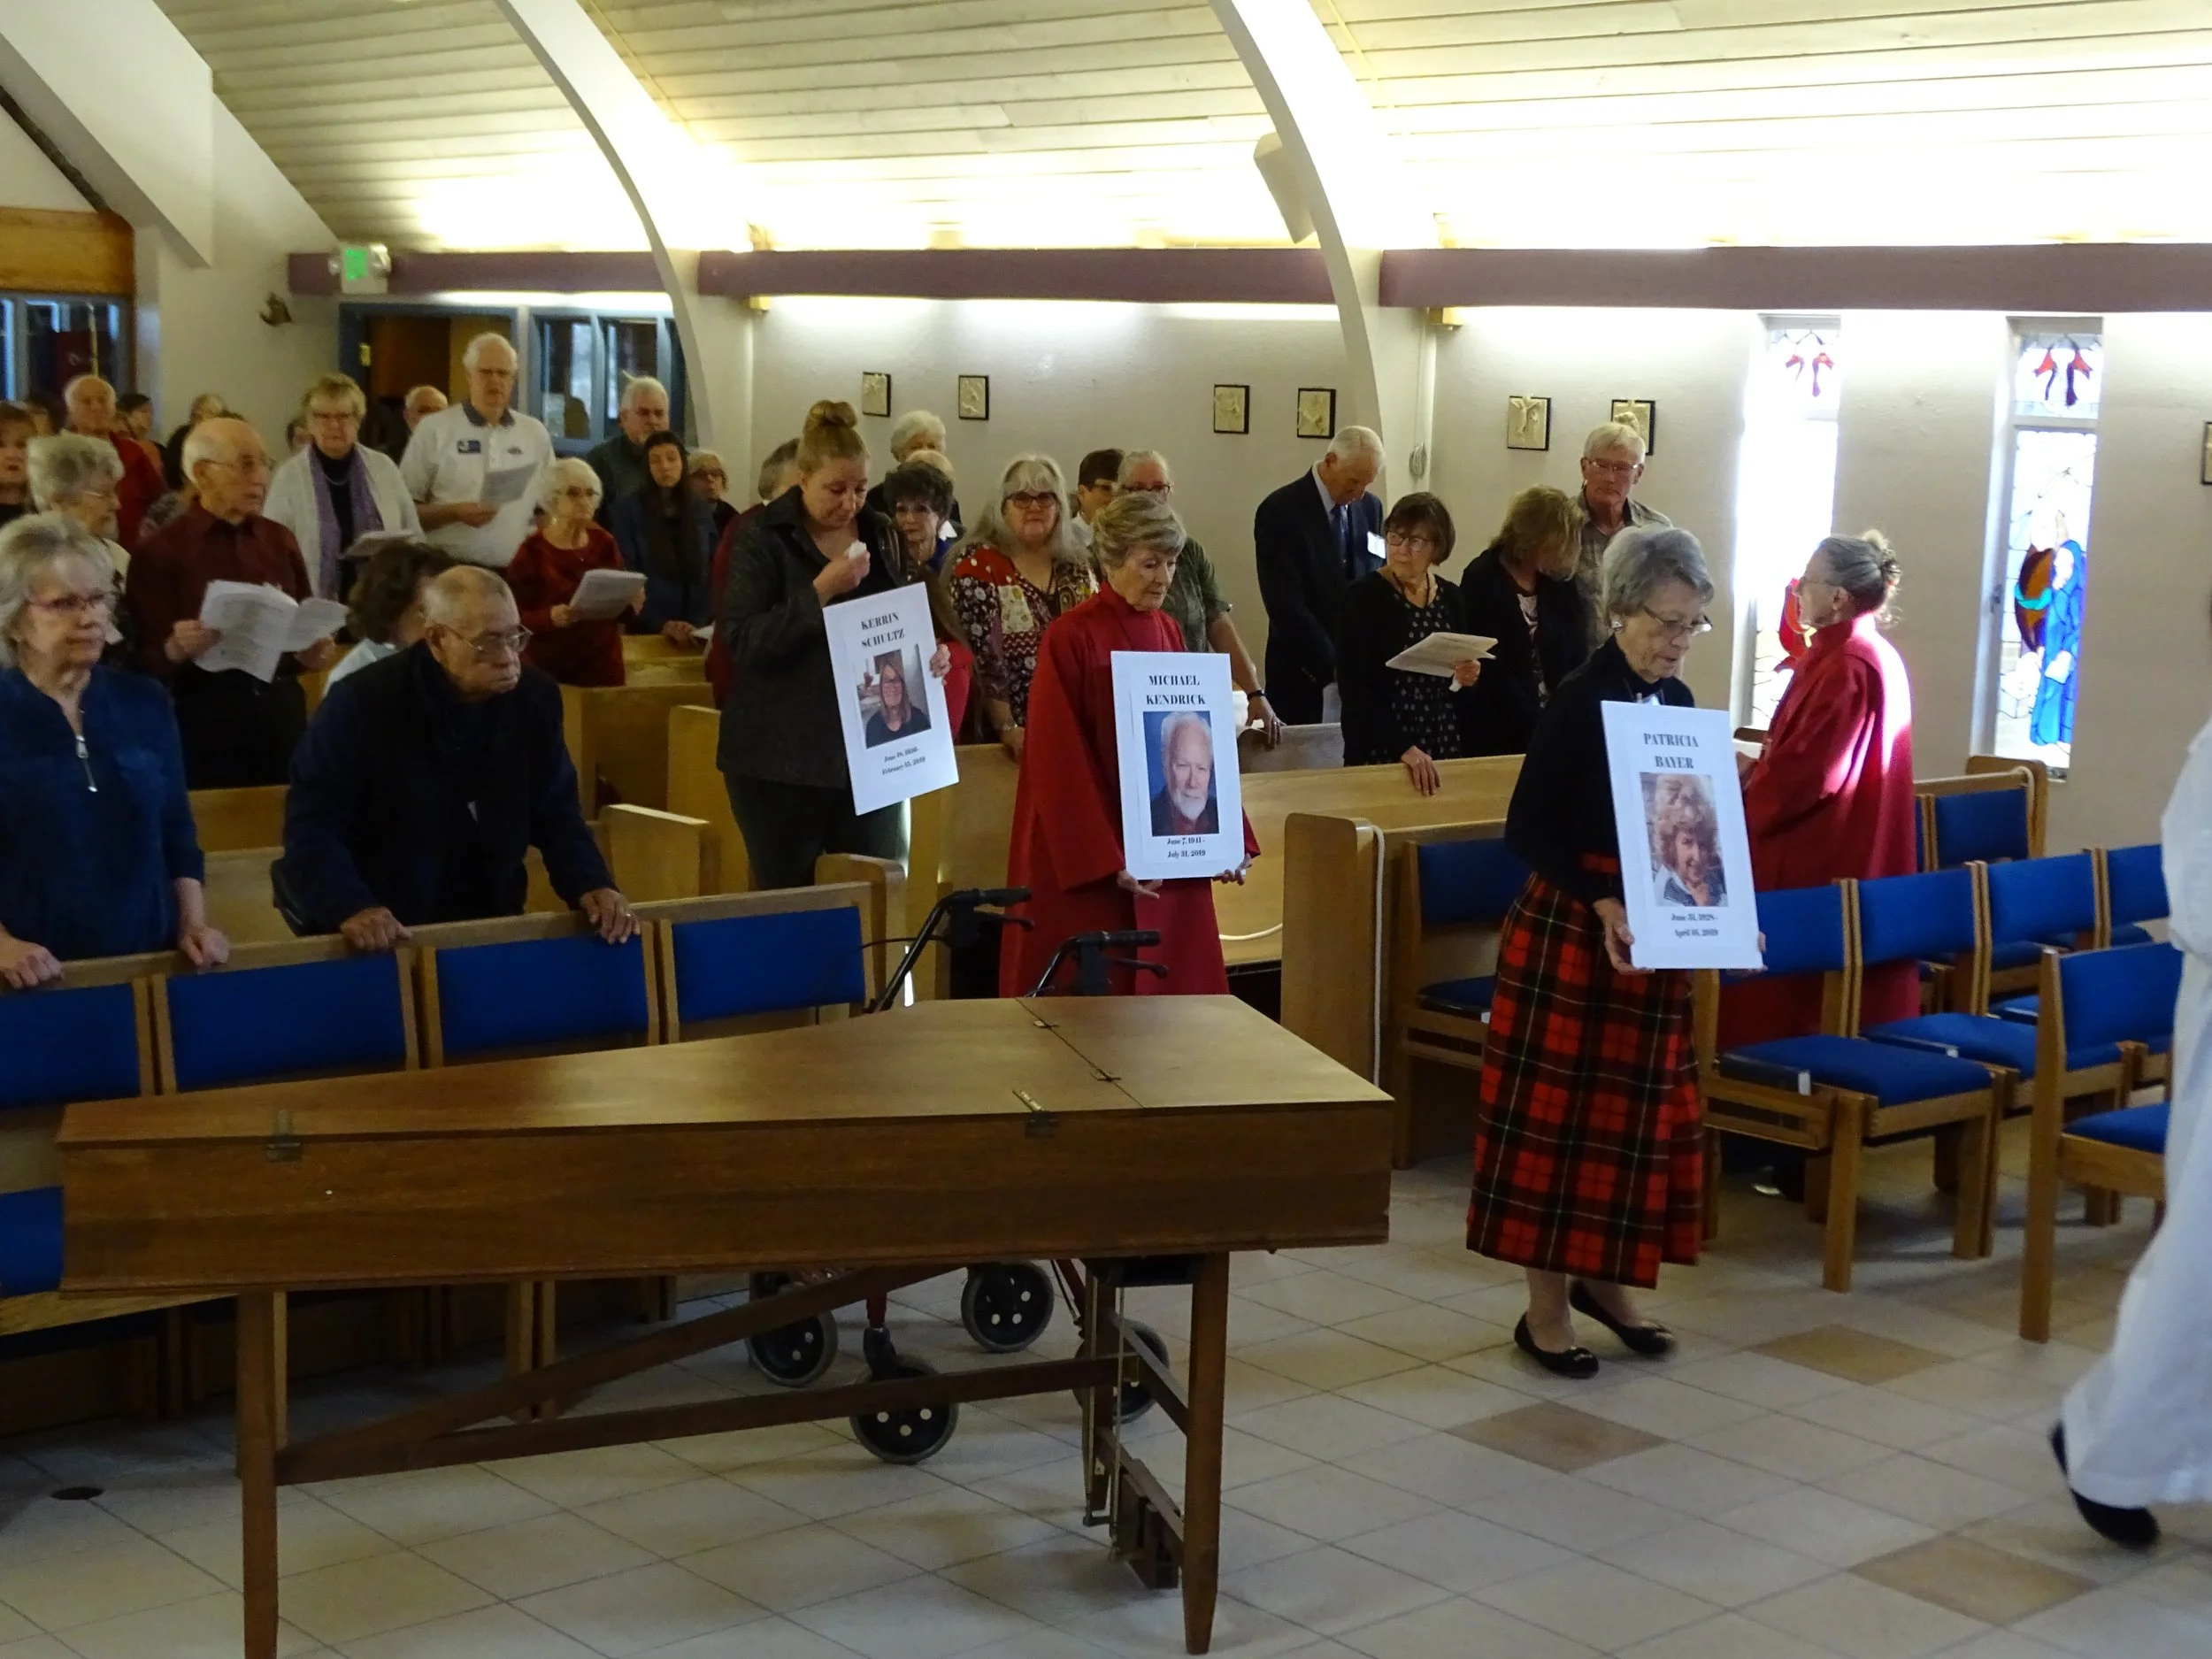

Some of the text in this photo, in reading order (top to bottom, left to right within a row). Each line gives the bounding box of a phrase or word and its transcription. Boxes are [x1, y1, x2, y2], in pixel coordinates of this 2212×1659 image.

[861, 612, 899, 630] KERRIN
[862, 628, 905, 647] SCHULTZ
[1148, 675, 1201, 686] MICHAEL
[1147, 695, 1206, 705] KENDRICK
[1643, 733, 1699, 748] PATRICIA
[1655, 756, 1694, 769] BAYER
[882, 764, 903, 775] February
[1167, 850, 1179, 859] July
[1674, 929, 1690, 939] April
